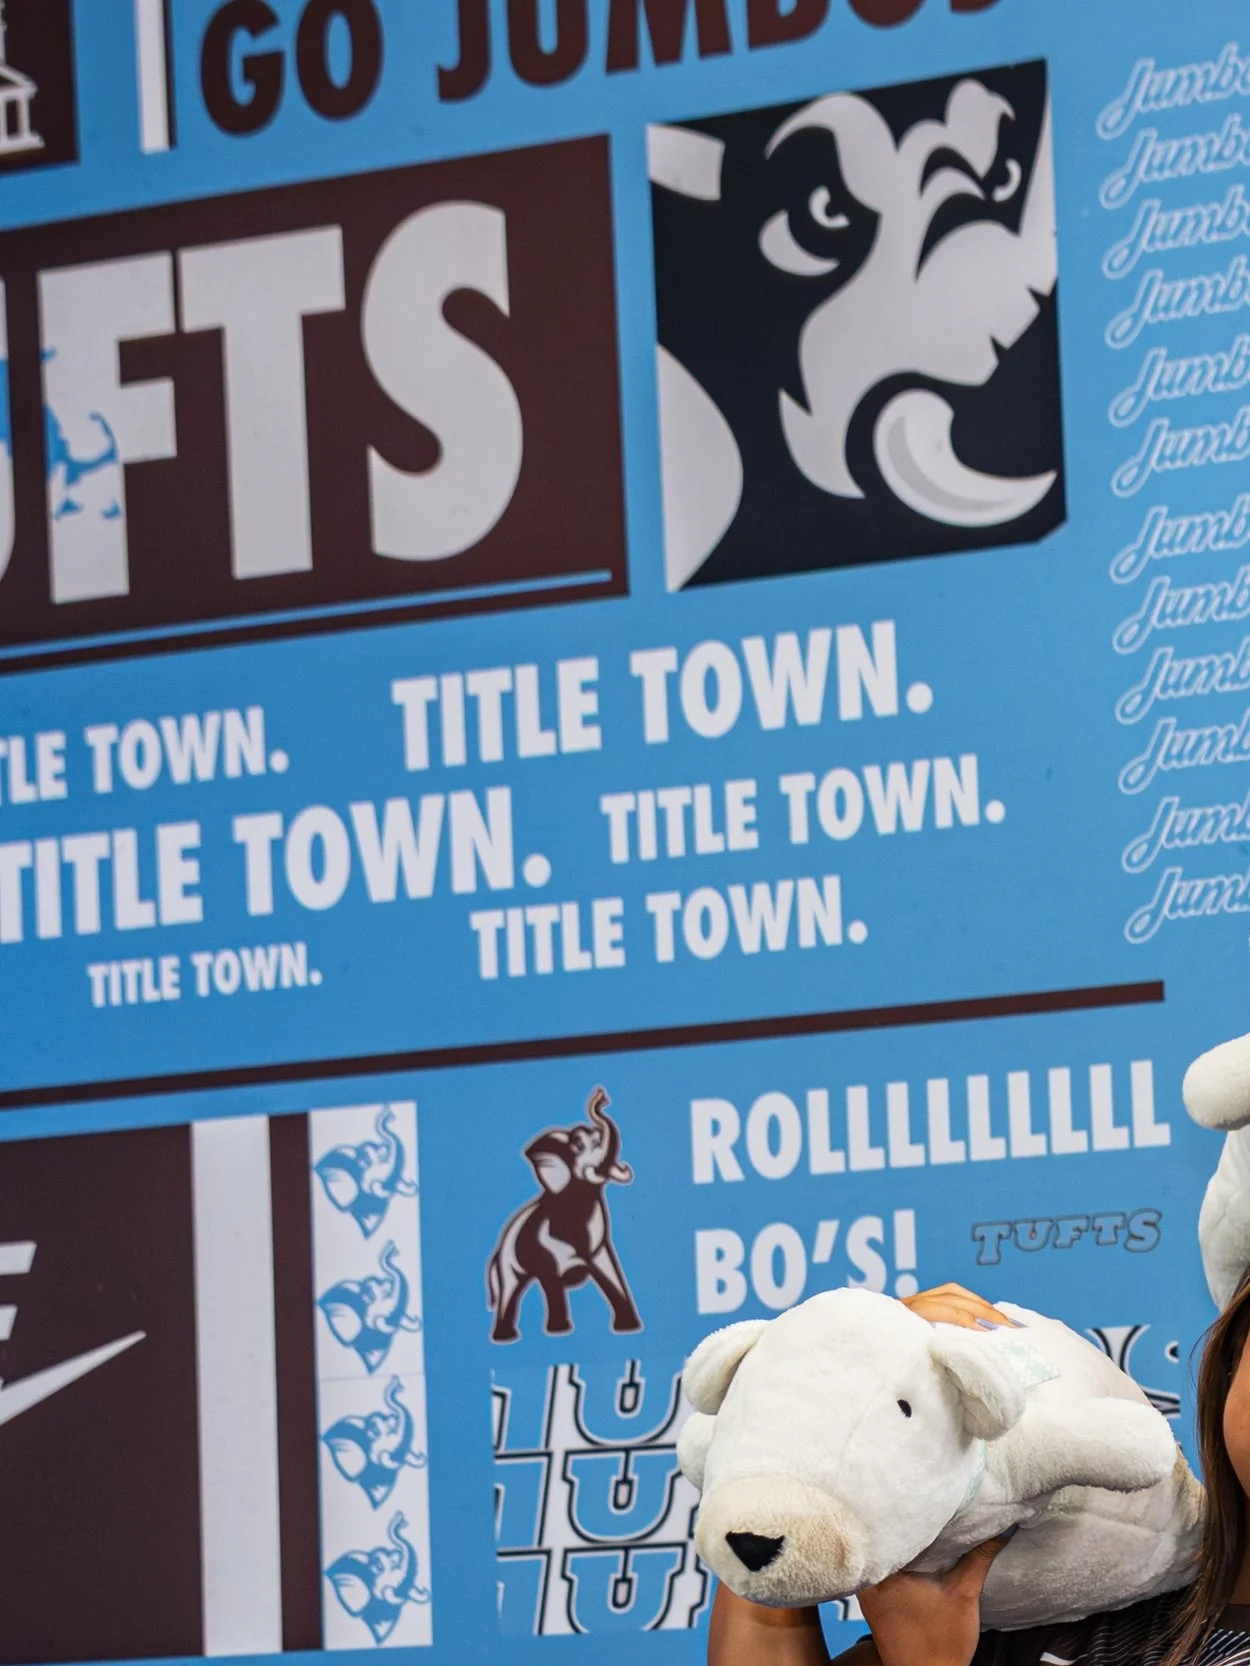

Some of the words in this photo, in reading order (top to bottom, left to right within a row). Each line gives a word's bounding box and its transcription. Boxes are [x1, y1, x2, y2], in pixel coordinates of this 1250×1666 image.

[200, 0, 384, 137] GO
[0, 199, 524, 604] FTS
[86, 707, 290, 792] TOWN.
[391, 656, 602, 772] TITLE
[630, 619, 934, 744] TOWN.
[0, 821, 203, 944] TITLE
[232, 787, 552, 915] TOWN.
[600, 779, 759, 864] TITLE
[779, 753, 1006, 845] TOWN.
[88, 956, 181, 1008] TITLE
[191, 942, 323, 998] TOWN.
[470, 897, 626, 980] TITLE
[645, 874, 869, 964] TOWN.
[690, 1059, 1171, 1185] ROLLLLLLLLL
[970, 1207, 1163, 1267] TUFTS
